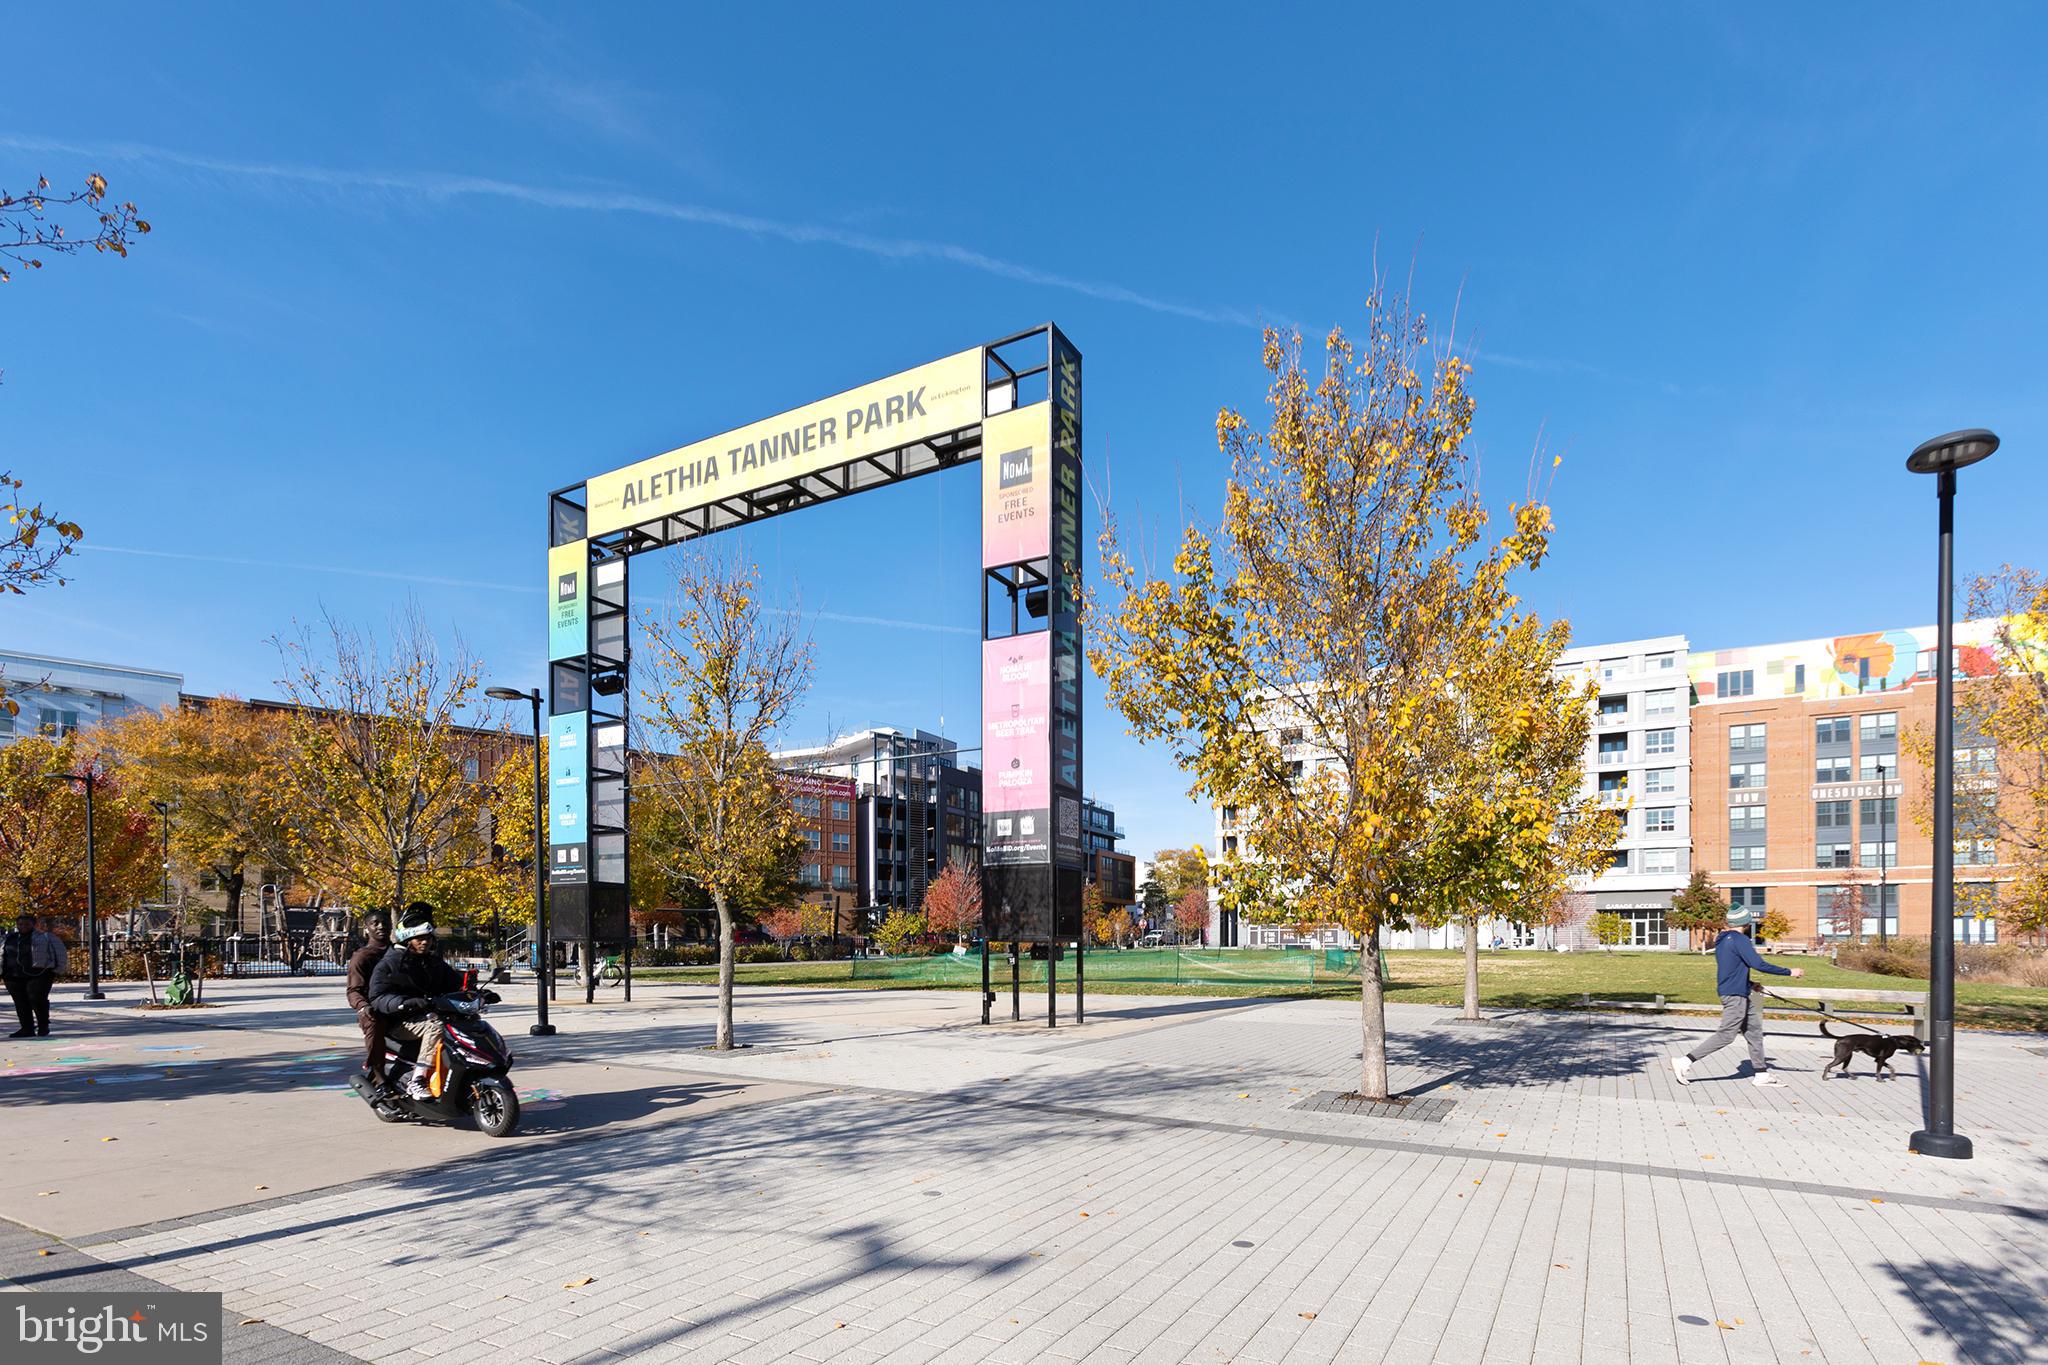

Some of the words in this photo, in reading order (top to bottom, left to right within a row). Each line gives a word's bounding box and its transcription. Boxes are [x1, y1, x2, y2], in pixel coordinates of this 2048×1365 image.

[1060, 351, 1077, 455] PARK
[622, 455, 719, 510] ALETHIA
[728, 417, 836, 475] TANNER
[846, 386, 927, 440] PARK
[1005, 497, 1027, 510] FREE
[998, 507, 1034, 523] EVENTS
[561, 609, 574, 619] FREE
[557, 617, 579, 628] EVENTS
[988, 716, 1045, 731] METROPOLITAN
[1735, 792, 1759, 803] NOW
